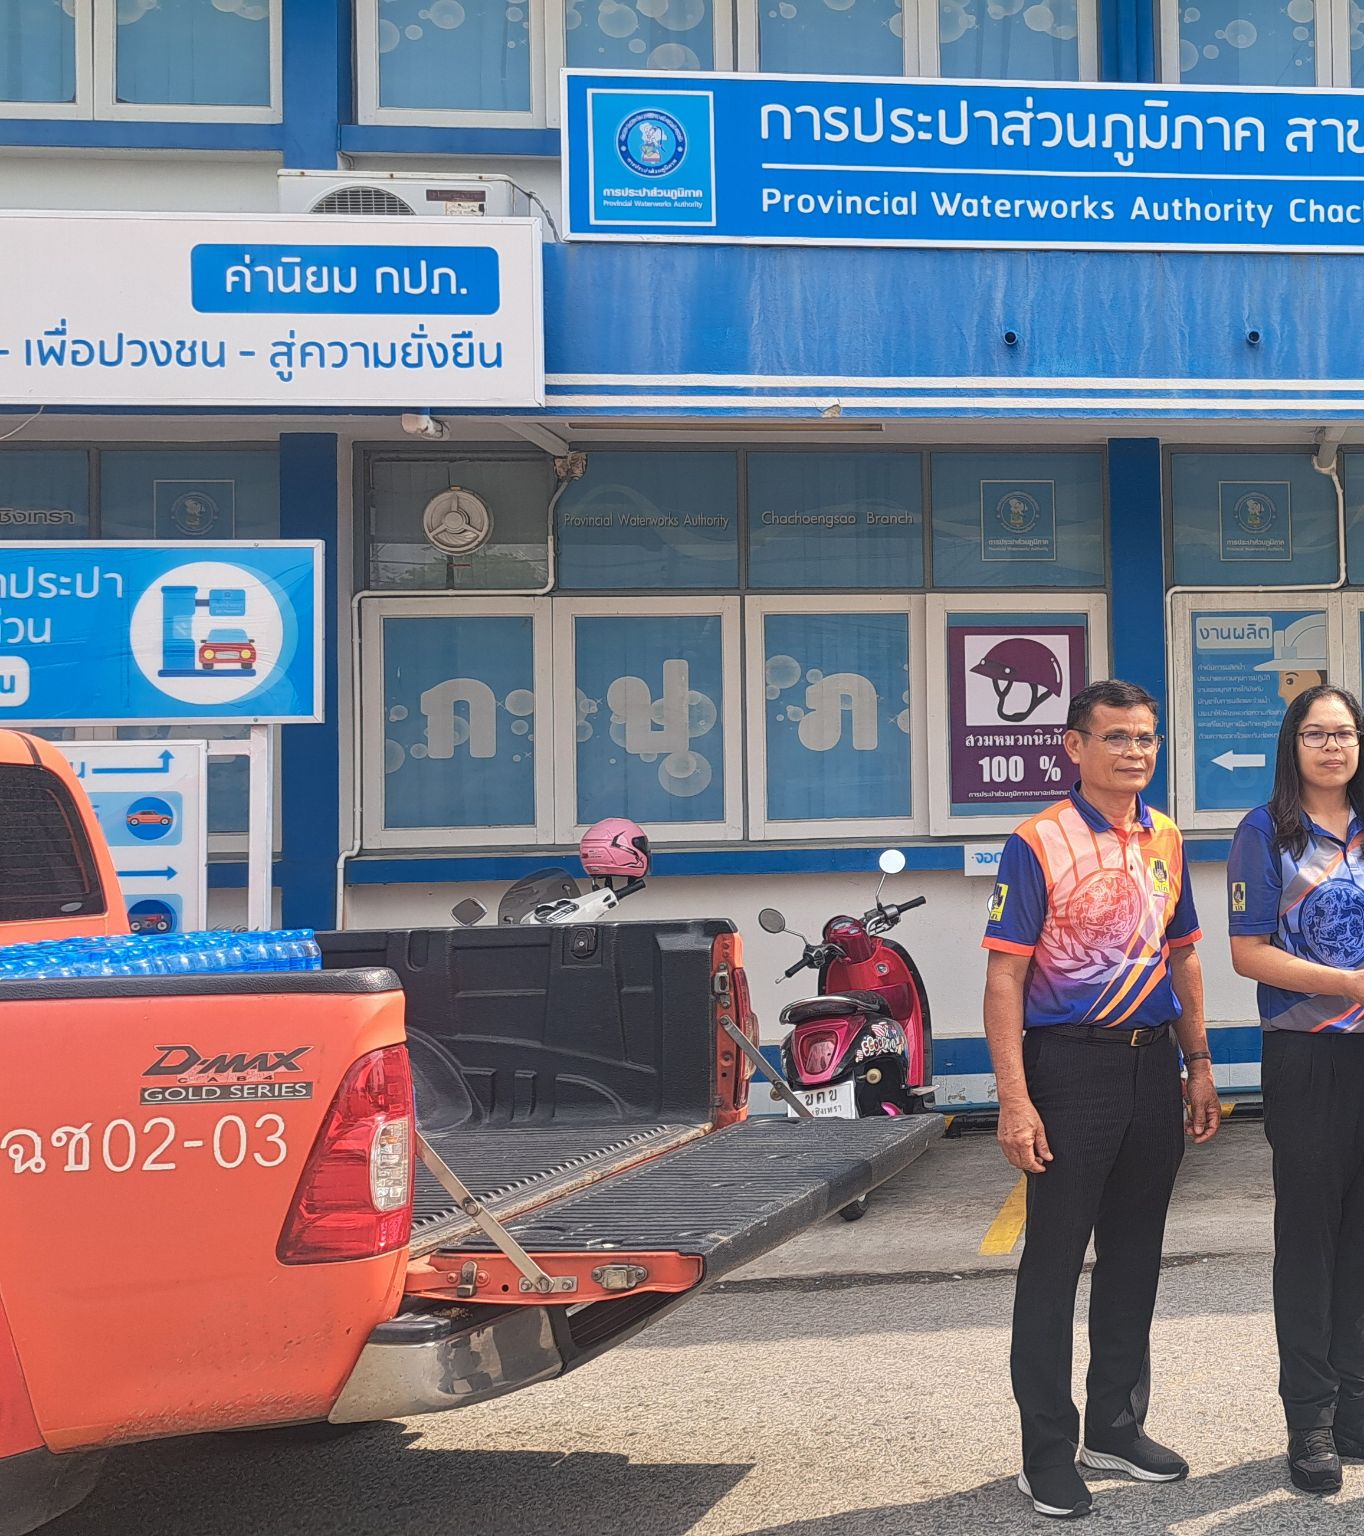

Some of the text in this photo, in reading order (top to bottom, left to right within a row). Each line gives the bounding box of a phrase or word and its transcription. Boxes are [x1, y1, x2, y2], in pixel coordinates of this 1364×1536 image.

[761, 96, 1264, 167] การประปาส่วนภูมิภาค
[761, 188, 917, 216] Provincial
[930, 190, 1115, 220] Waterworks
[1130, 196, 1273, 229] Authority
[225, 254, 468, 296] ค่านิยม กปภ.
[25, 319, 226, 368] เพื่อปวงชน
[270, 323, 502, 382] สู่ความยั่งยืน
[563, 512, 730, 529] Provincial Waterworks Authority
[761, 511, 914, 529] Chachoengsao Branch
[1199, 622, 1270, 641] งานผลิต
[965, 727, 1064, 747] สวมหมวกนิรภั
[978, 755, 1061, 783] 100 %
[143, 1083, 307, 1101] GOLD SERIES
